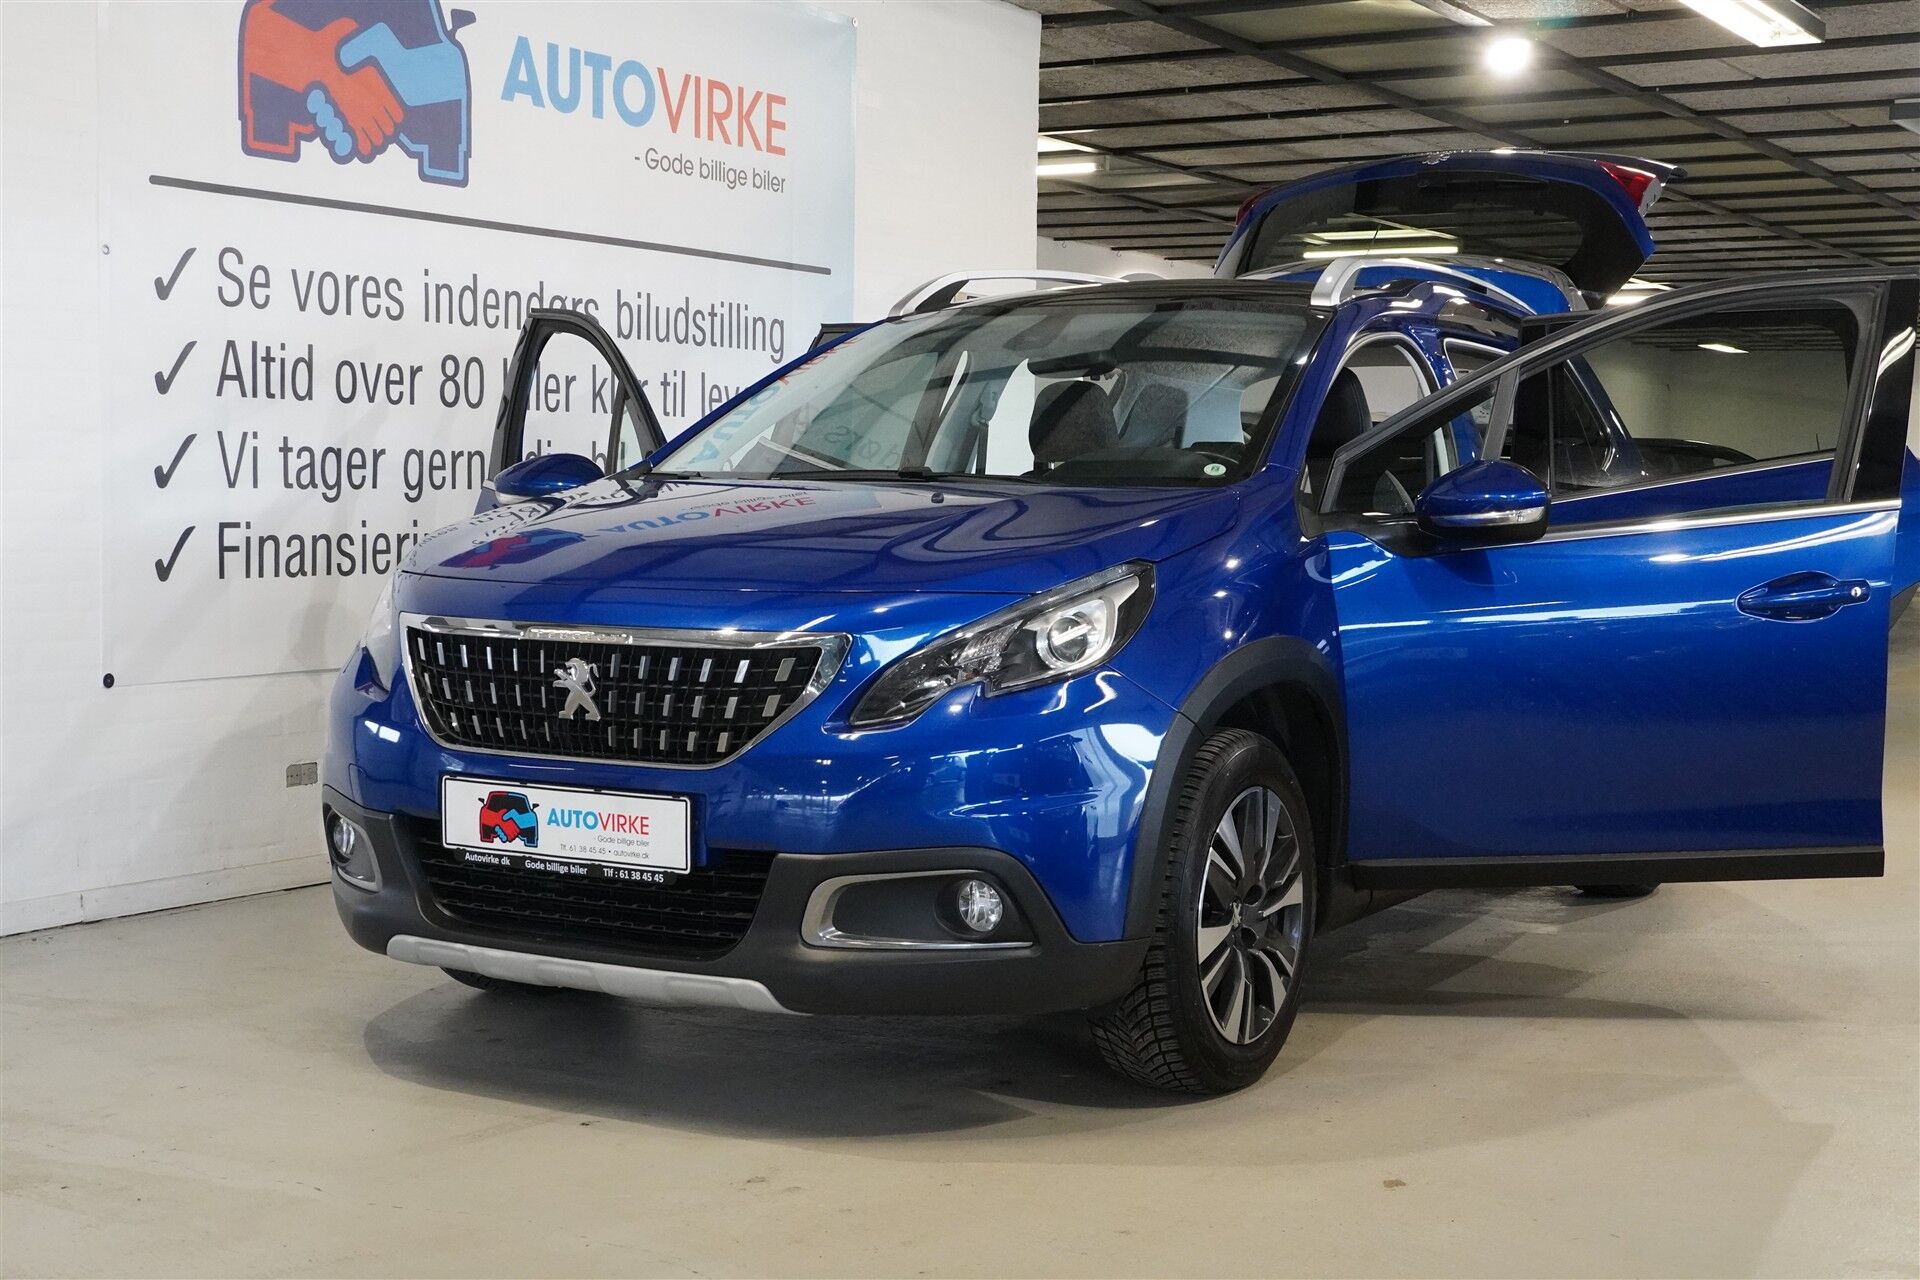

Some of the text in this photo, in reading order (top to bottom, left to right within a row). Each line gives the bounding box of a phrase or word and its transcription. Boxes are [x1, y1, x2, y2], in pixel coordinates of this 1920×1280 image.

[501, 35, 787, 157] AUTOVIRKE
[645, 147, 694, 177] Gode
[699, 157, 748, 190] billige
[752, 168, 786, 194] biler
[217, 246, 271, 310] Se
[291, 268, 405, 322] vores
[616, 289, 785, 364] biludstilling
[216, 339, 314, 402] Altid
[335, 359, 423, 406] over
[439, 354, 485, 409] 80
[660, 370, 686, 418] til
[217, 430, 486, 503] Vi tager gern
[218, 519, 428, 580] Finansieri
[547, 808, 649, 836] AUTOVIRKE
[569, 844, 577, 852] 61
[579, 845, 587, 853] 38
[588, 846, 597, 854] 45
[598, 847, 606, 855] 45
[525, 859, 545, 871] Gode
[546, 861, 569, 875] billige
[570, 864, 588, 875] biler
[619, 870, 629, 880] 61
[631, 871, 641, 881] 38
[642, 872, 652, 882] 45
[653, 873, 664, 883] 45
